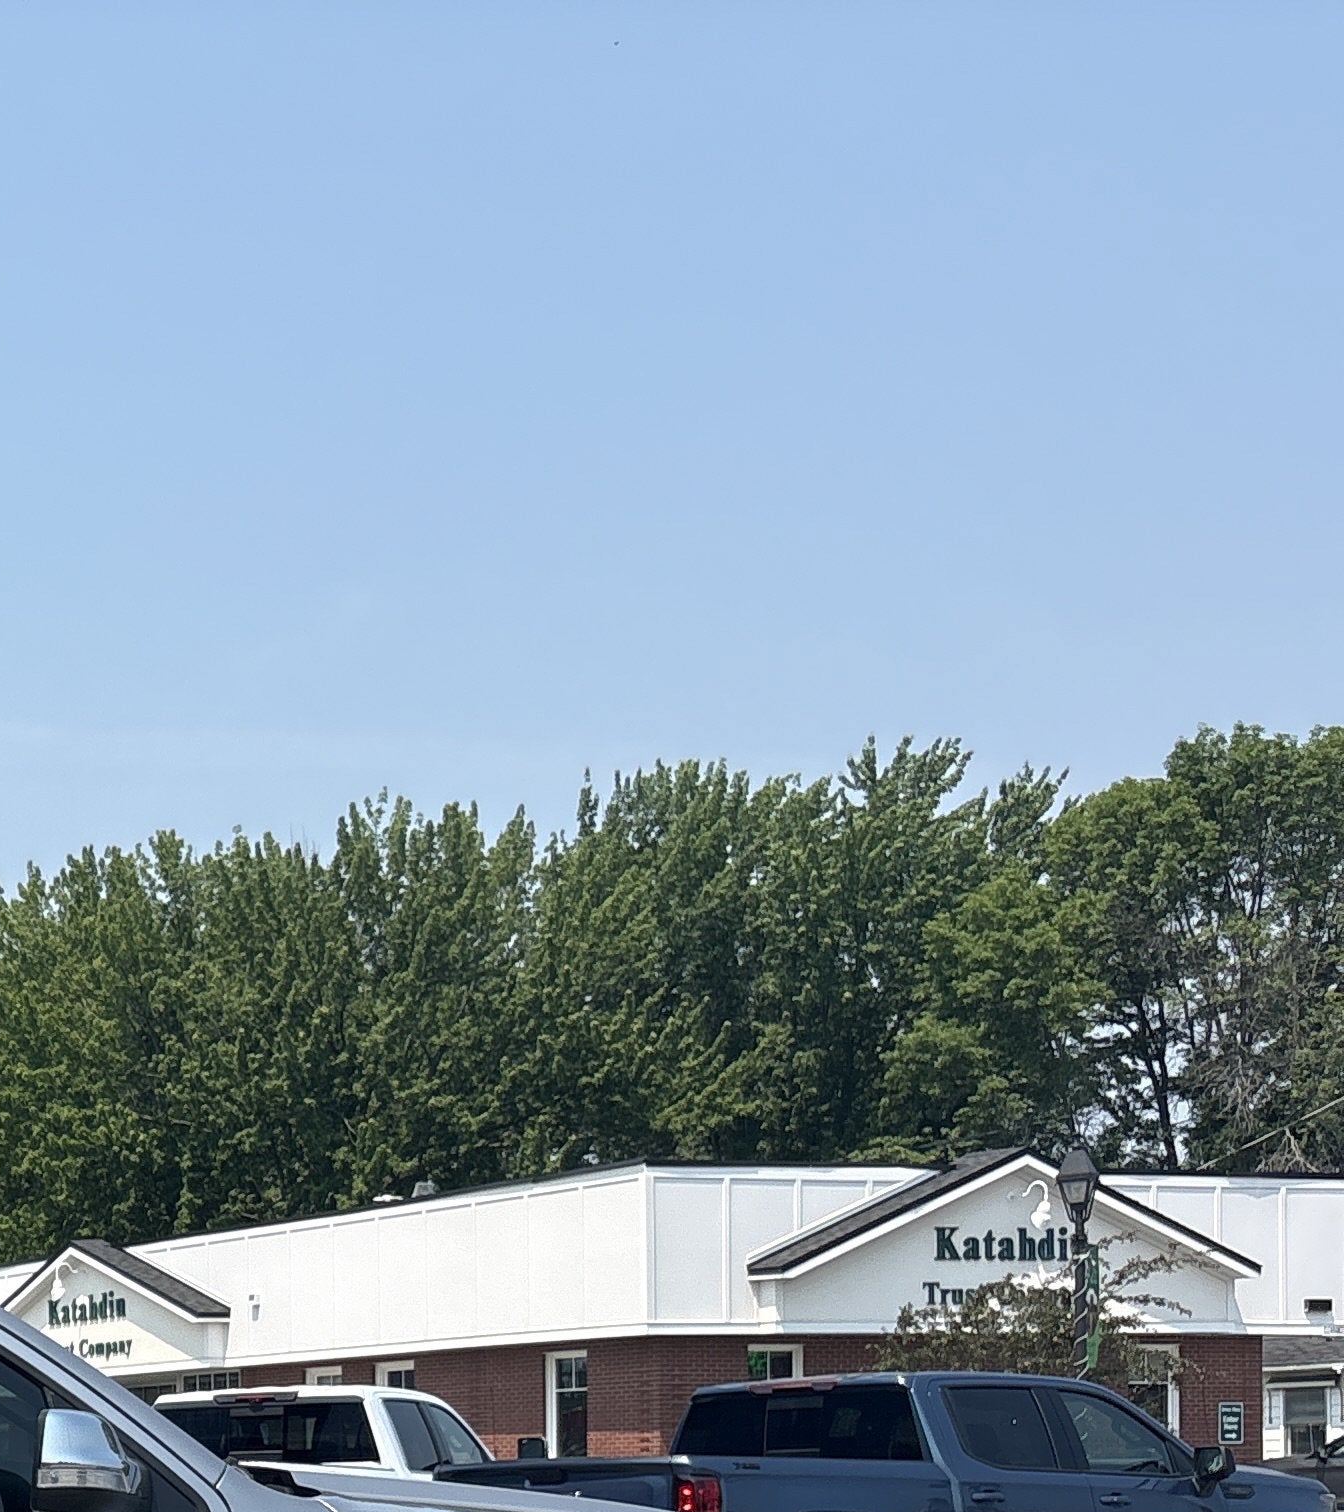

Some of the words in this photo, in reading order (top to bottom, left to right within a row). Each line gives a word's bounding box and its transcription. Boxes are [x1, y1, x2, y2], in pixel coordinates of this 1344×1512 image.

[934, 1226, 1070, 1262] Katahdi
[922, 1281, 980, 1306] Trus
[47, 1290, 127, 1328] Katahdin
[78, 1338, 133, 1361] Company
